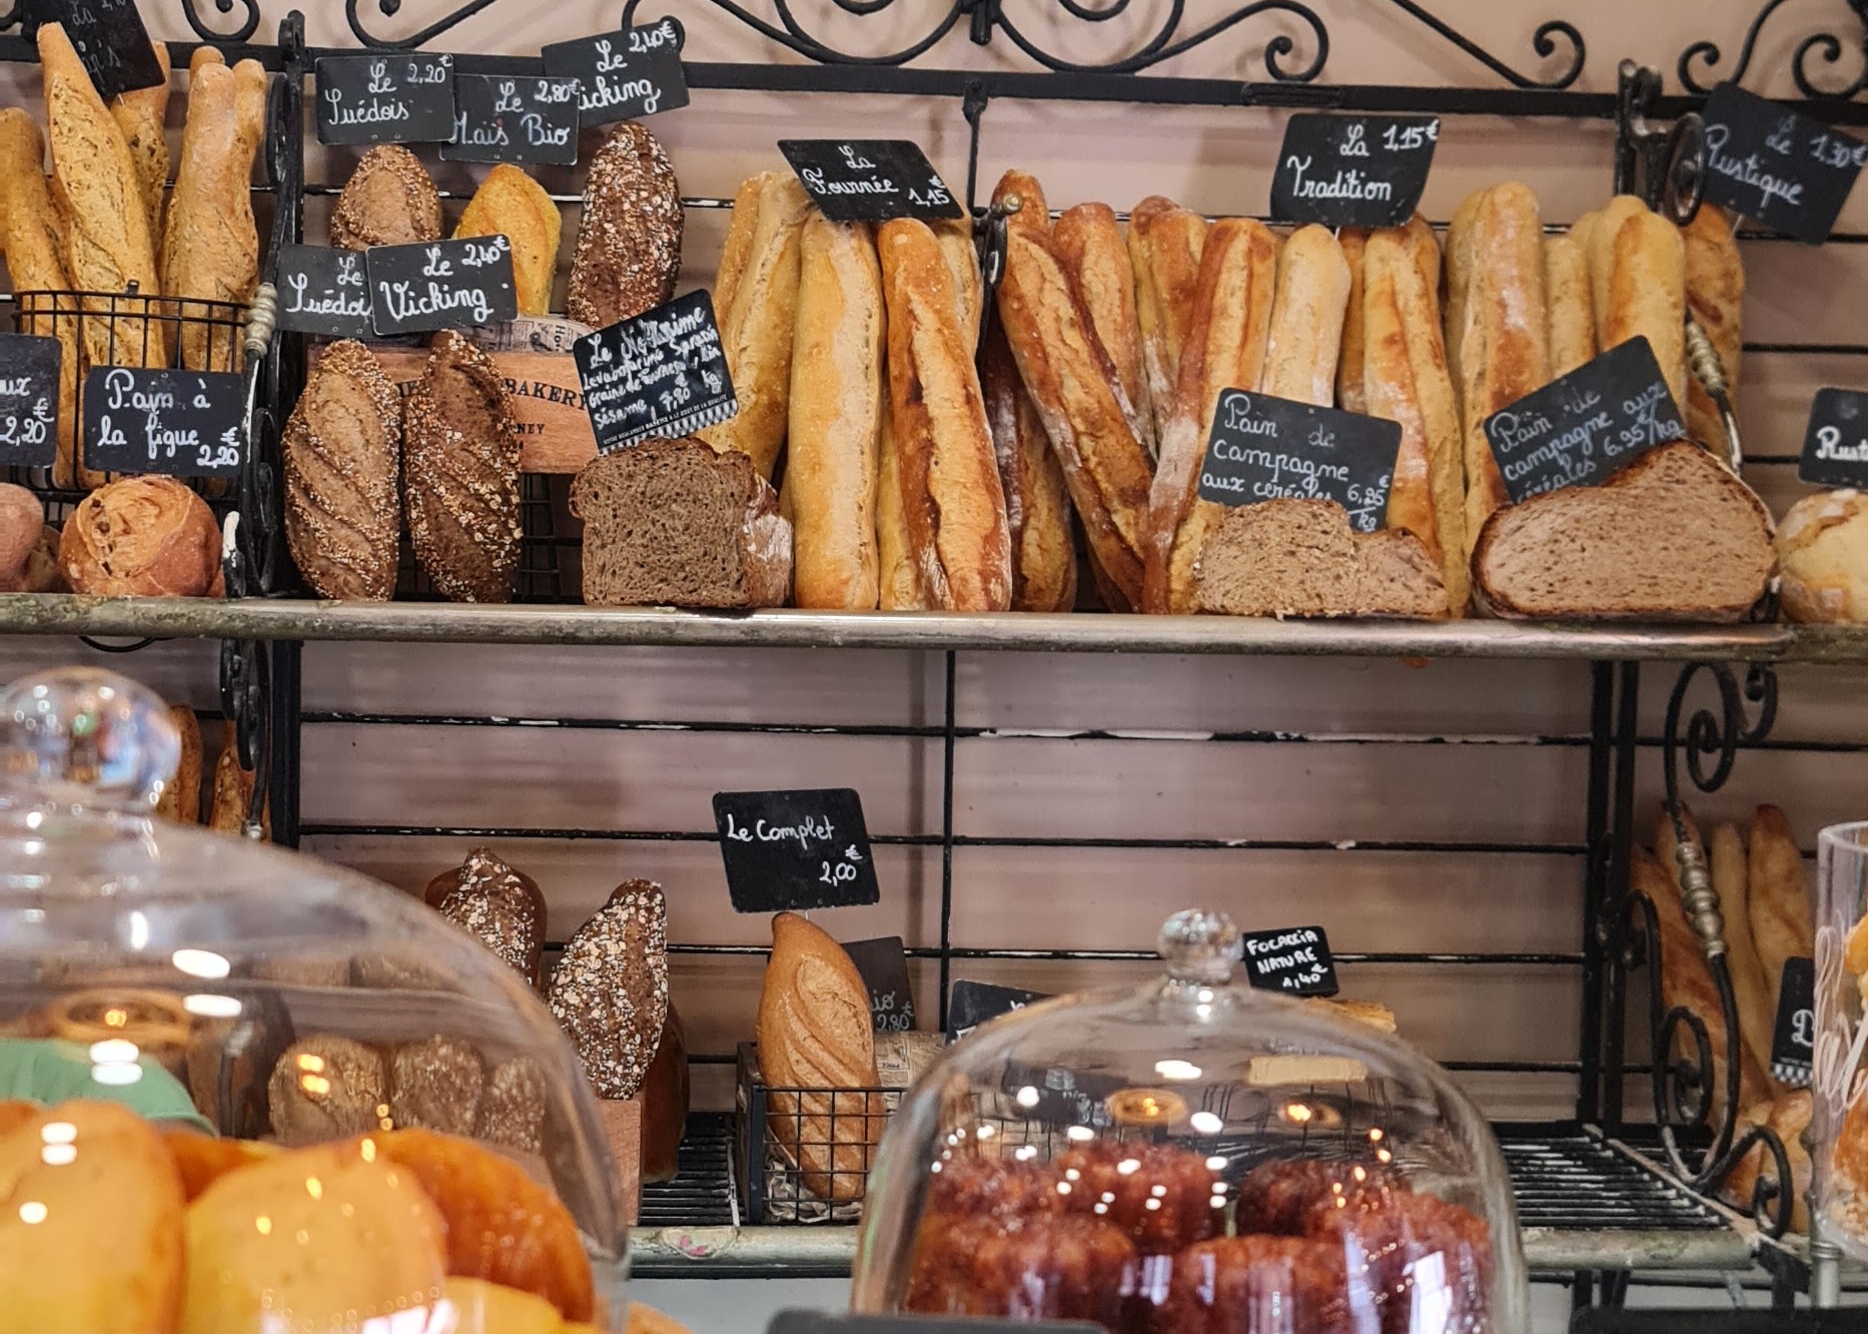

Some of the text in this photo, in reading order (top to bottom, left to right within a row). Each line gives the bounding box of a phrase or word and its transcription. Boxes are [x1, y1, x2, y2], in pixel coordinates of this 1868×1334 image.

[595, 40, 628, 72] Le
[368, 63, 397, 93] Le
[579, 76, 662, 114] icking
[325, 88, 409, 125] Suédois
[495, 81, 524, 112] Le
[520, 113, 571, 145] Bio
[1339, 124, 1370, 157] La
[1765, 114, 1798, 155] Le
[838, 145, 876, 169] La
[1704, 123, 1804, 208] Rustique
[802, 167, 899, 195] Fournée
[1286, 155, 1392, 201] Tradition
[337, 256, 363, 286] Le
[423, 247, 454, 276] Le
[285, 272, 372, 316] Suédoi
[379, 280, 494, 322] Vicking
[588, 333, 613, 368] Le
[105, 369, 211, 411] Pain à
[97, 415, 200, 460] la figue
[1224, 393, 1336, 448] Pain de
[1490, 411, 1553, 453] Pain
[1202, 471, 1246, 493] aux
[727, 814, 835, 850] Le Complet
[1257, 946, 1318, 974] NATURE
